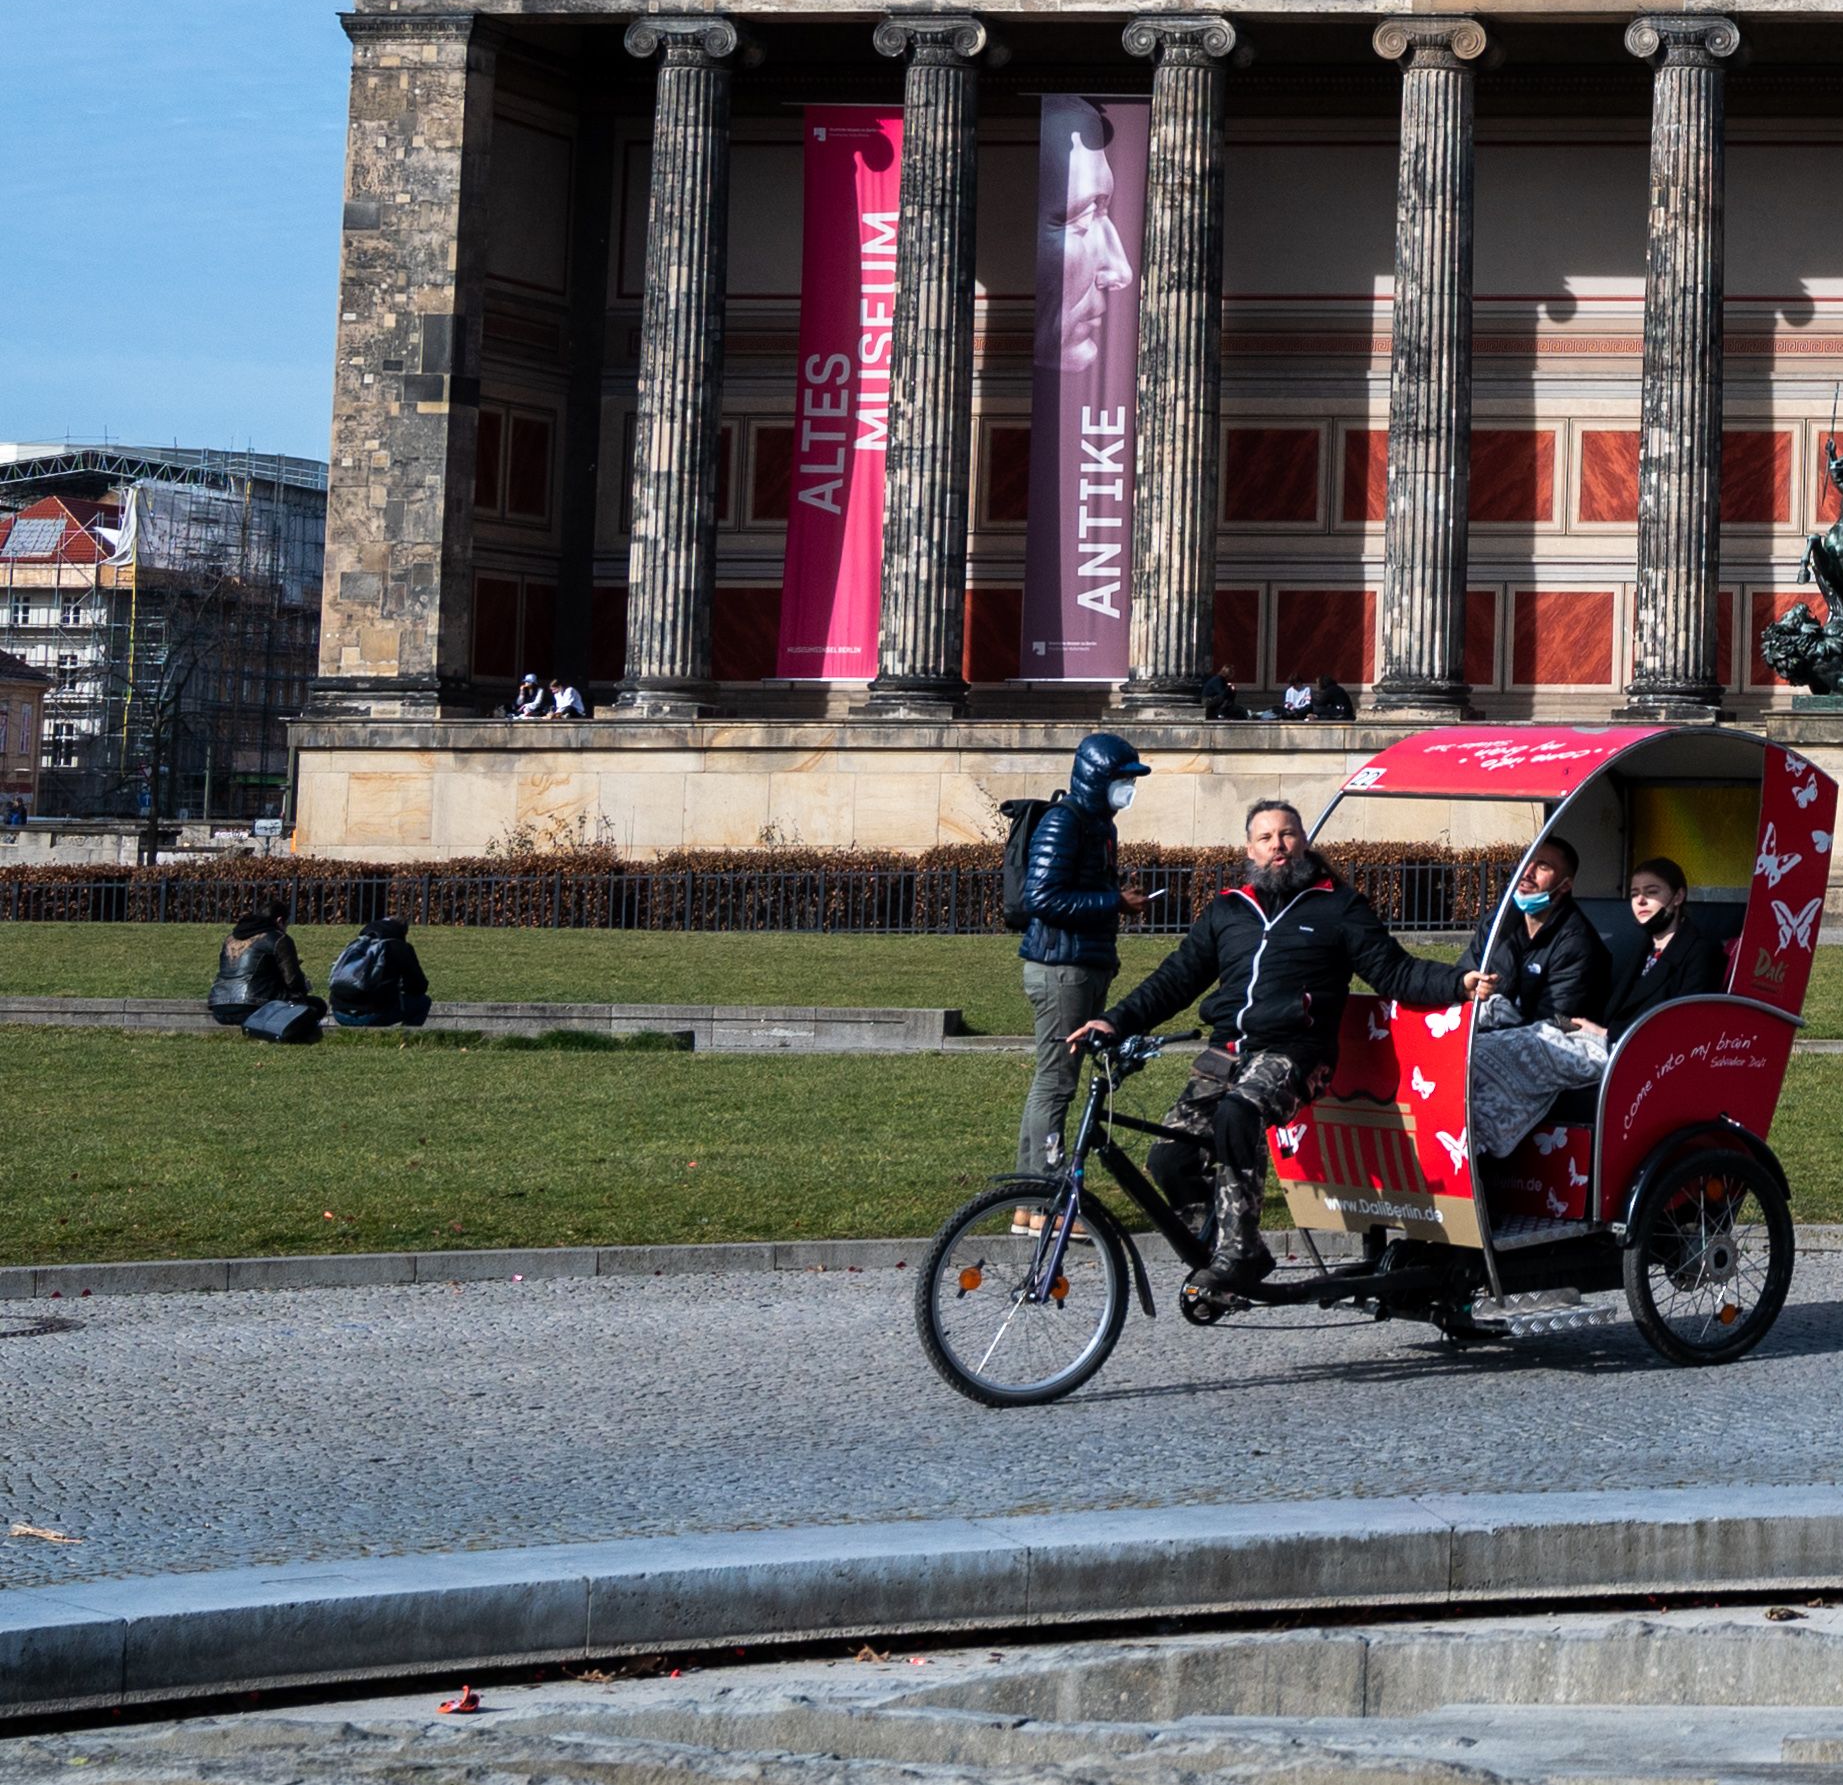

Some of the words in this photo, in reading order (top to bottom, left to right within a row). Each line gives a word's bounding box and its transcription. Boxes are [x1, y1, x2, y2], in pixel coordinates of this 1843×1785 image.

[853, 211, 900, 452] MUSEUM
[799, 353, 851, 516] ALTES
[1077, 404, 1126, 619] ANTIKE
[1350, 770, 1381, 787] 22
[1324, 1196, 1444, 1223] www.DaliBerlin.de
